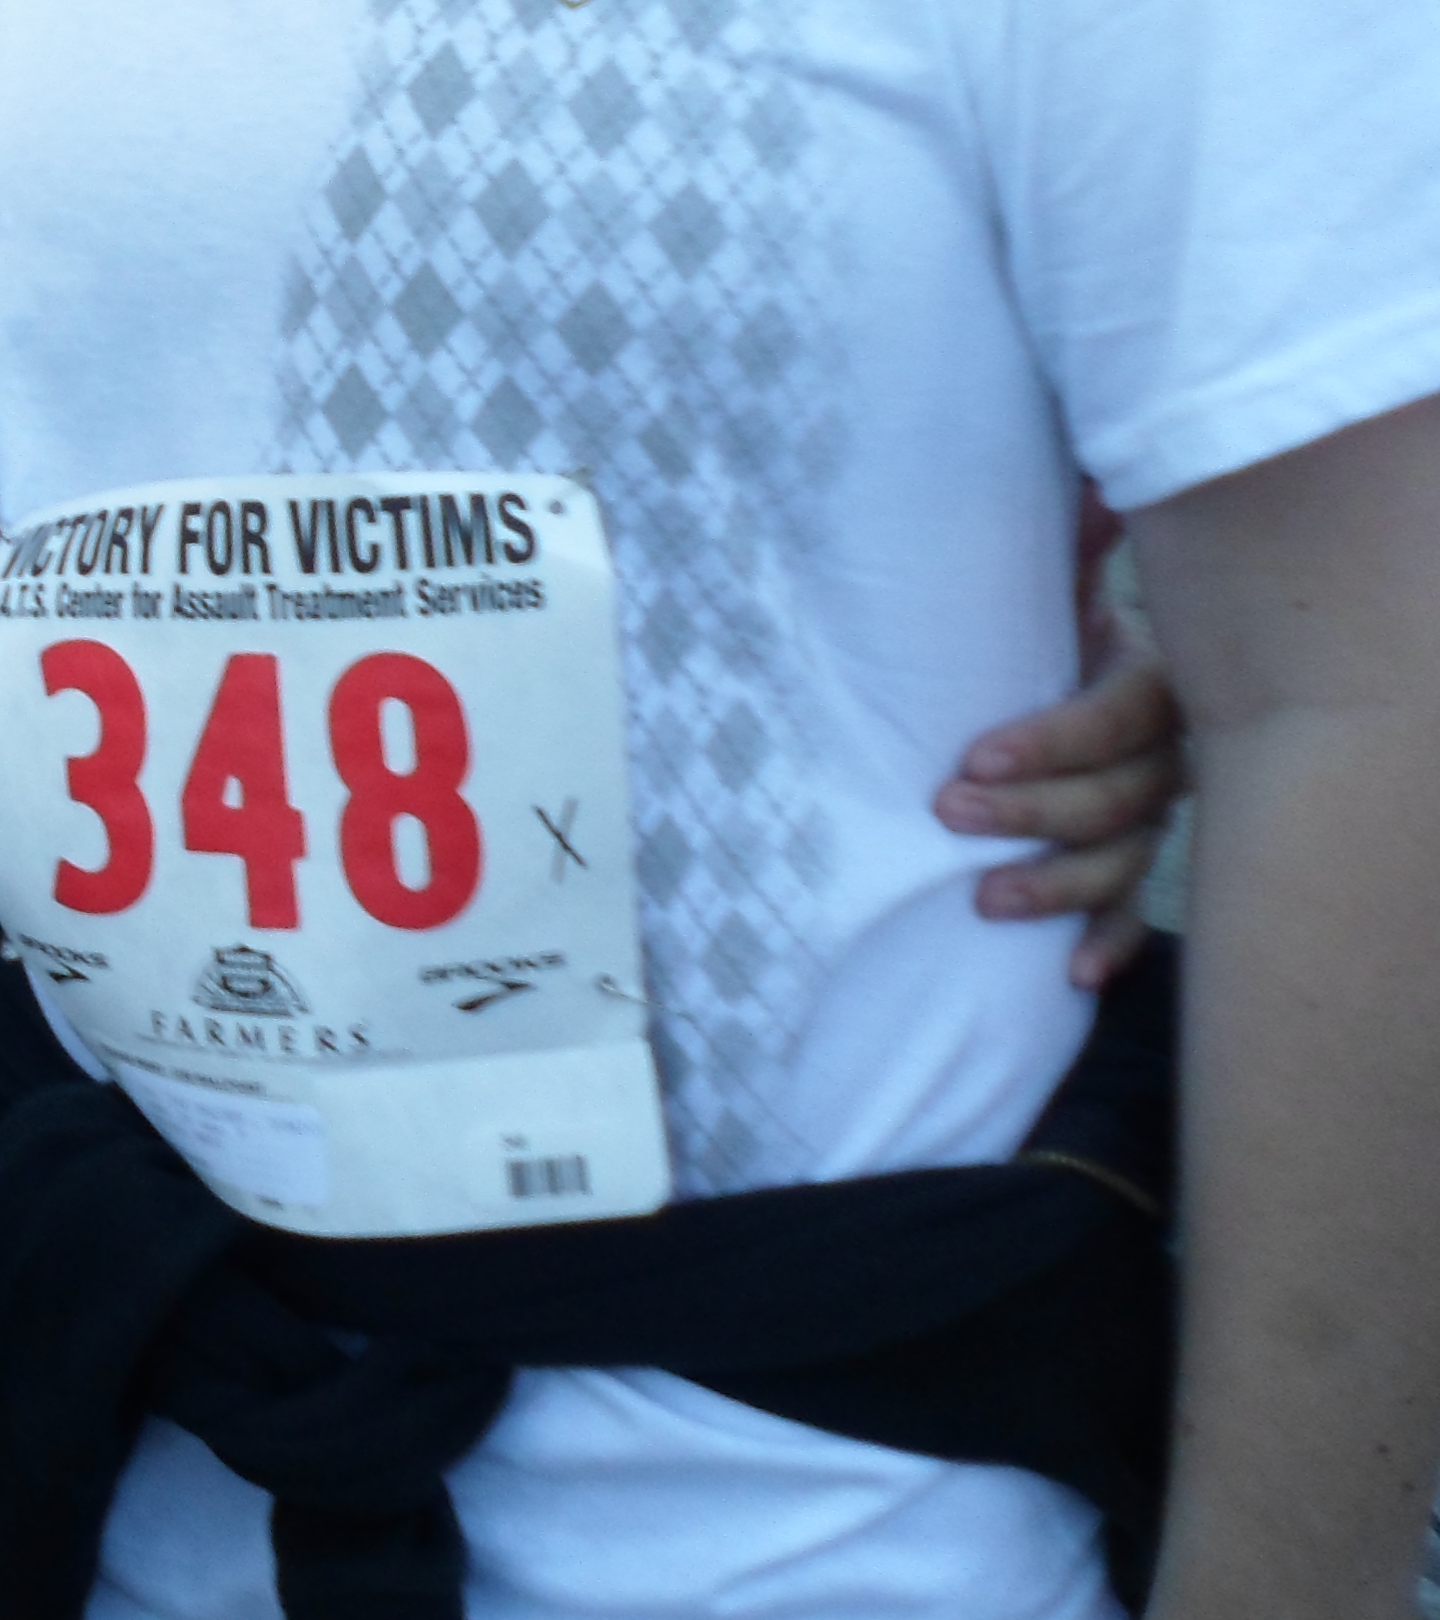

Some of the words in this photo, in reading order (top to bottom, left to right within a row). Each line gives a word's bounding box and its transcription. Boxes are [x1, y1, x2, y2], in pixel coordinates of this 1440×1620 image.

[2, 503, 164, 579] VICTORY
[177, 499, 272, 576] FOR
[288, 491, 537, 576] VICTIMS
[54, 582, 121, 619] Center
[131, 585, 162, 620] for
[170, 584, 258, 621] Assault
[266, 583, 407, 620] Treatment
[416, 576, 546, 616] Services
[39, 638, 483, 931] 348
[148, 1010, 373, 1053] FARMERS
